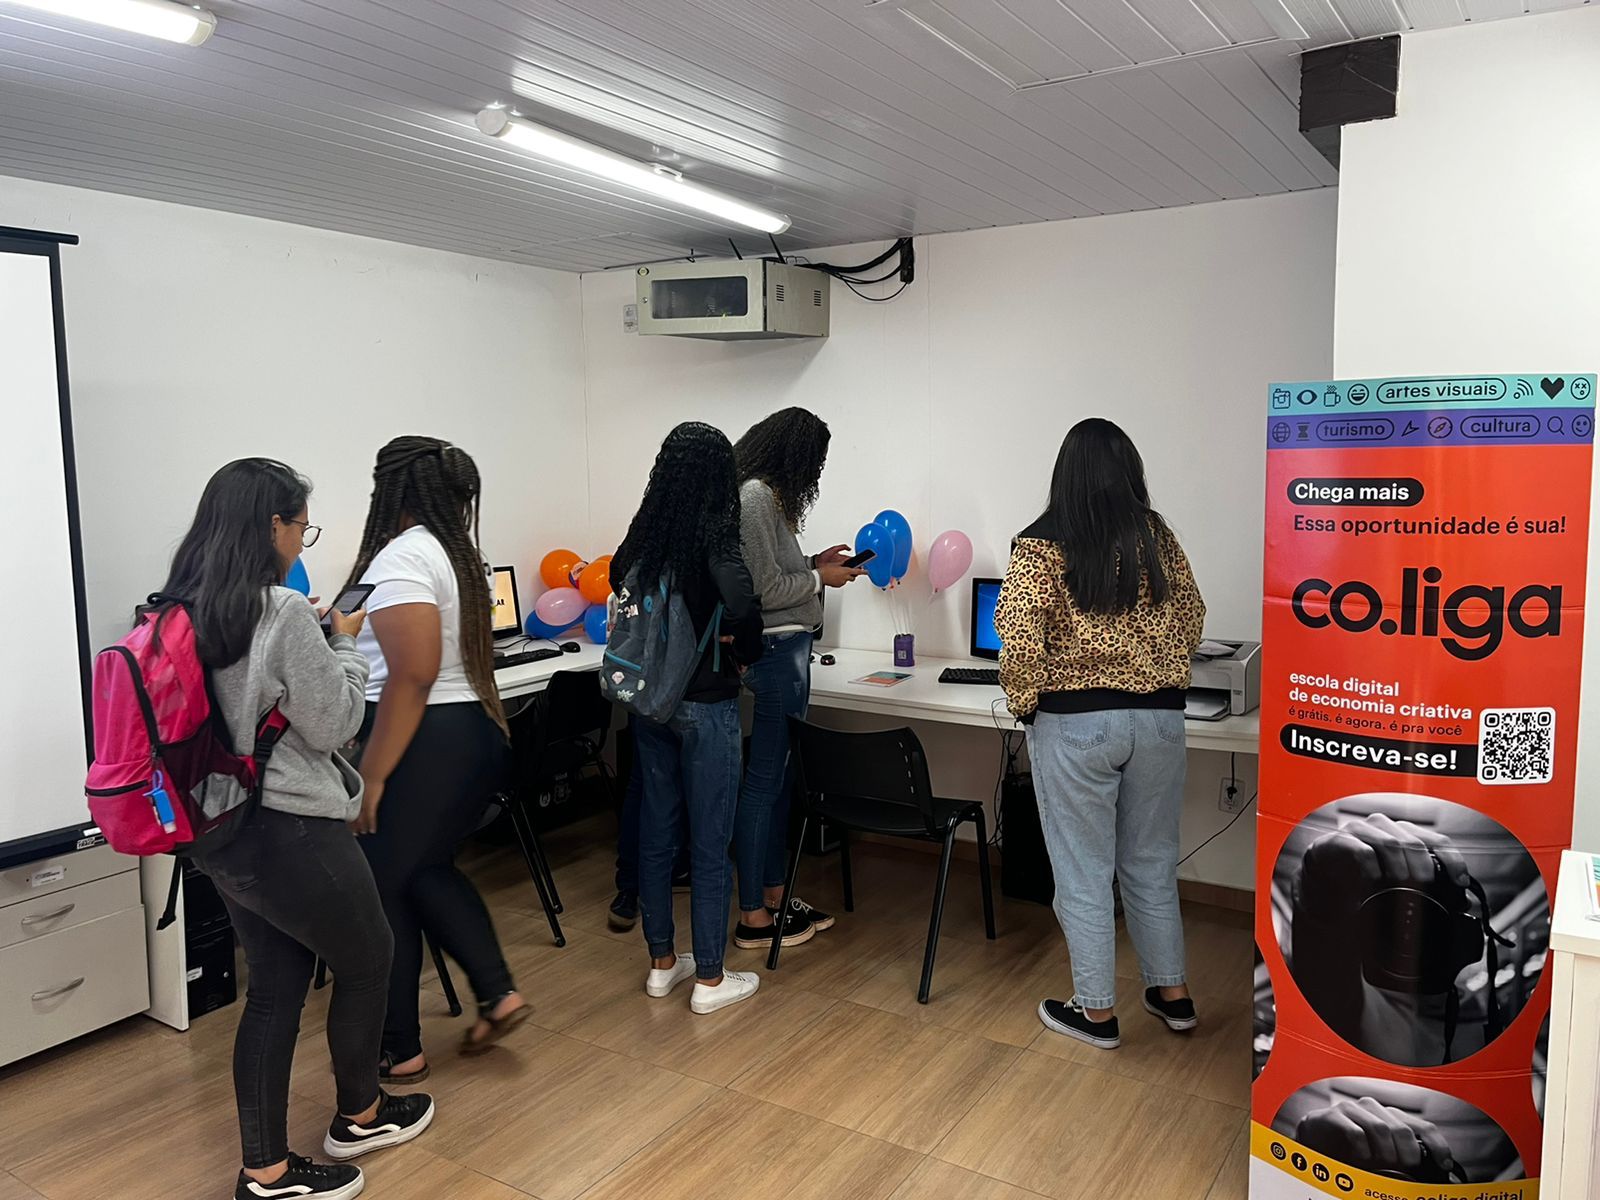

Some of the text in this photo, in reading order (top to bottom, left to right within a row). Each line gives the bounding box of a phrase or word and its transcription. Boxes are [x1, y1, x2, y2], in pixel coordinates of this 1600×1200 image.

[1385, 381, 1498, 399] artes visuais
[1324, 422, 1385, 437] turismo
[1470, 418, 1531, 433] cultura
[1294, 482, 1409, 503] Chega mais
[1294, 515, 1566, 535] Essa oportunidade é sua!
[1292, 566, 1563, 661] co.liga
[1289, 673, 1399, 697] escola digital
[1289, 687, 1472, 720] de economia criativa
[1288, 705, 1463, 736] é grátis. é agora. é pra você
[1291, 729, 1457, 771] Inscreva-se!
